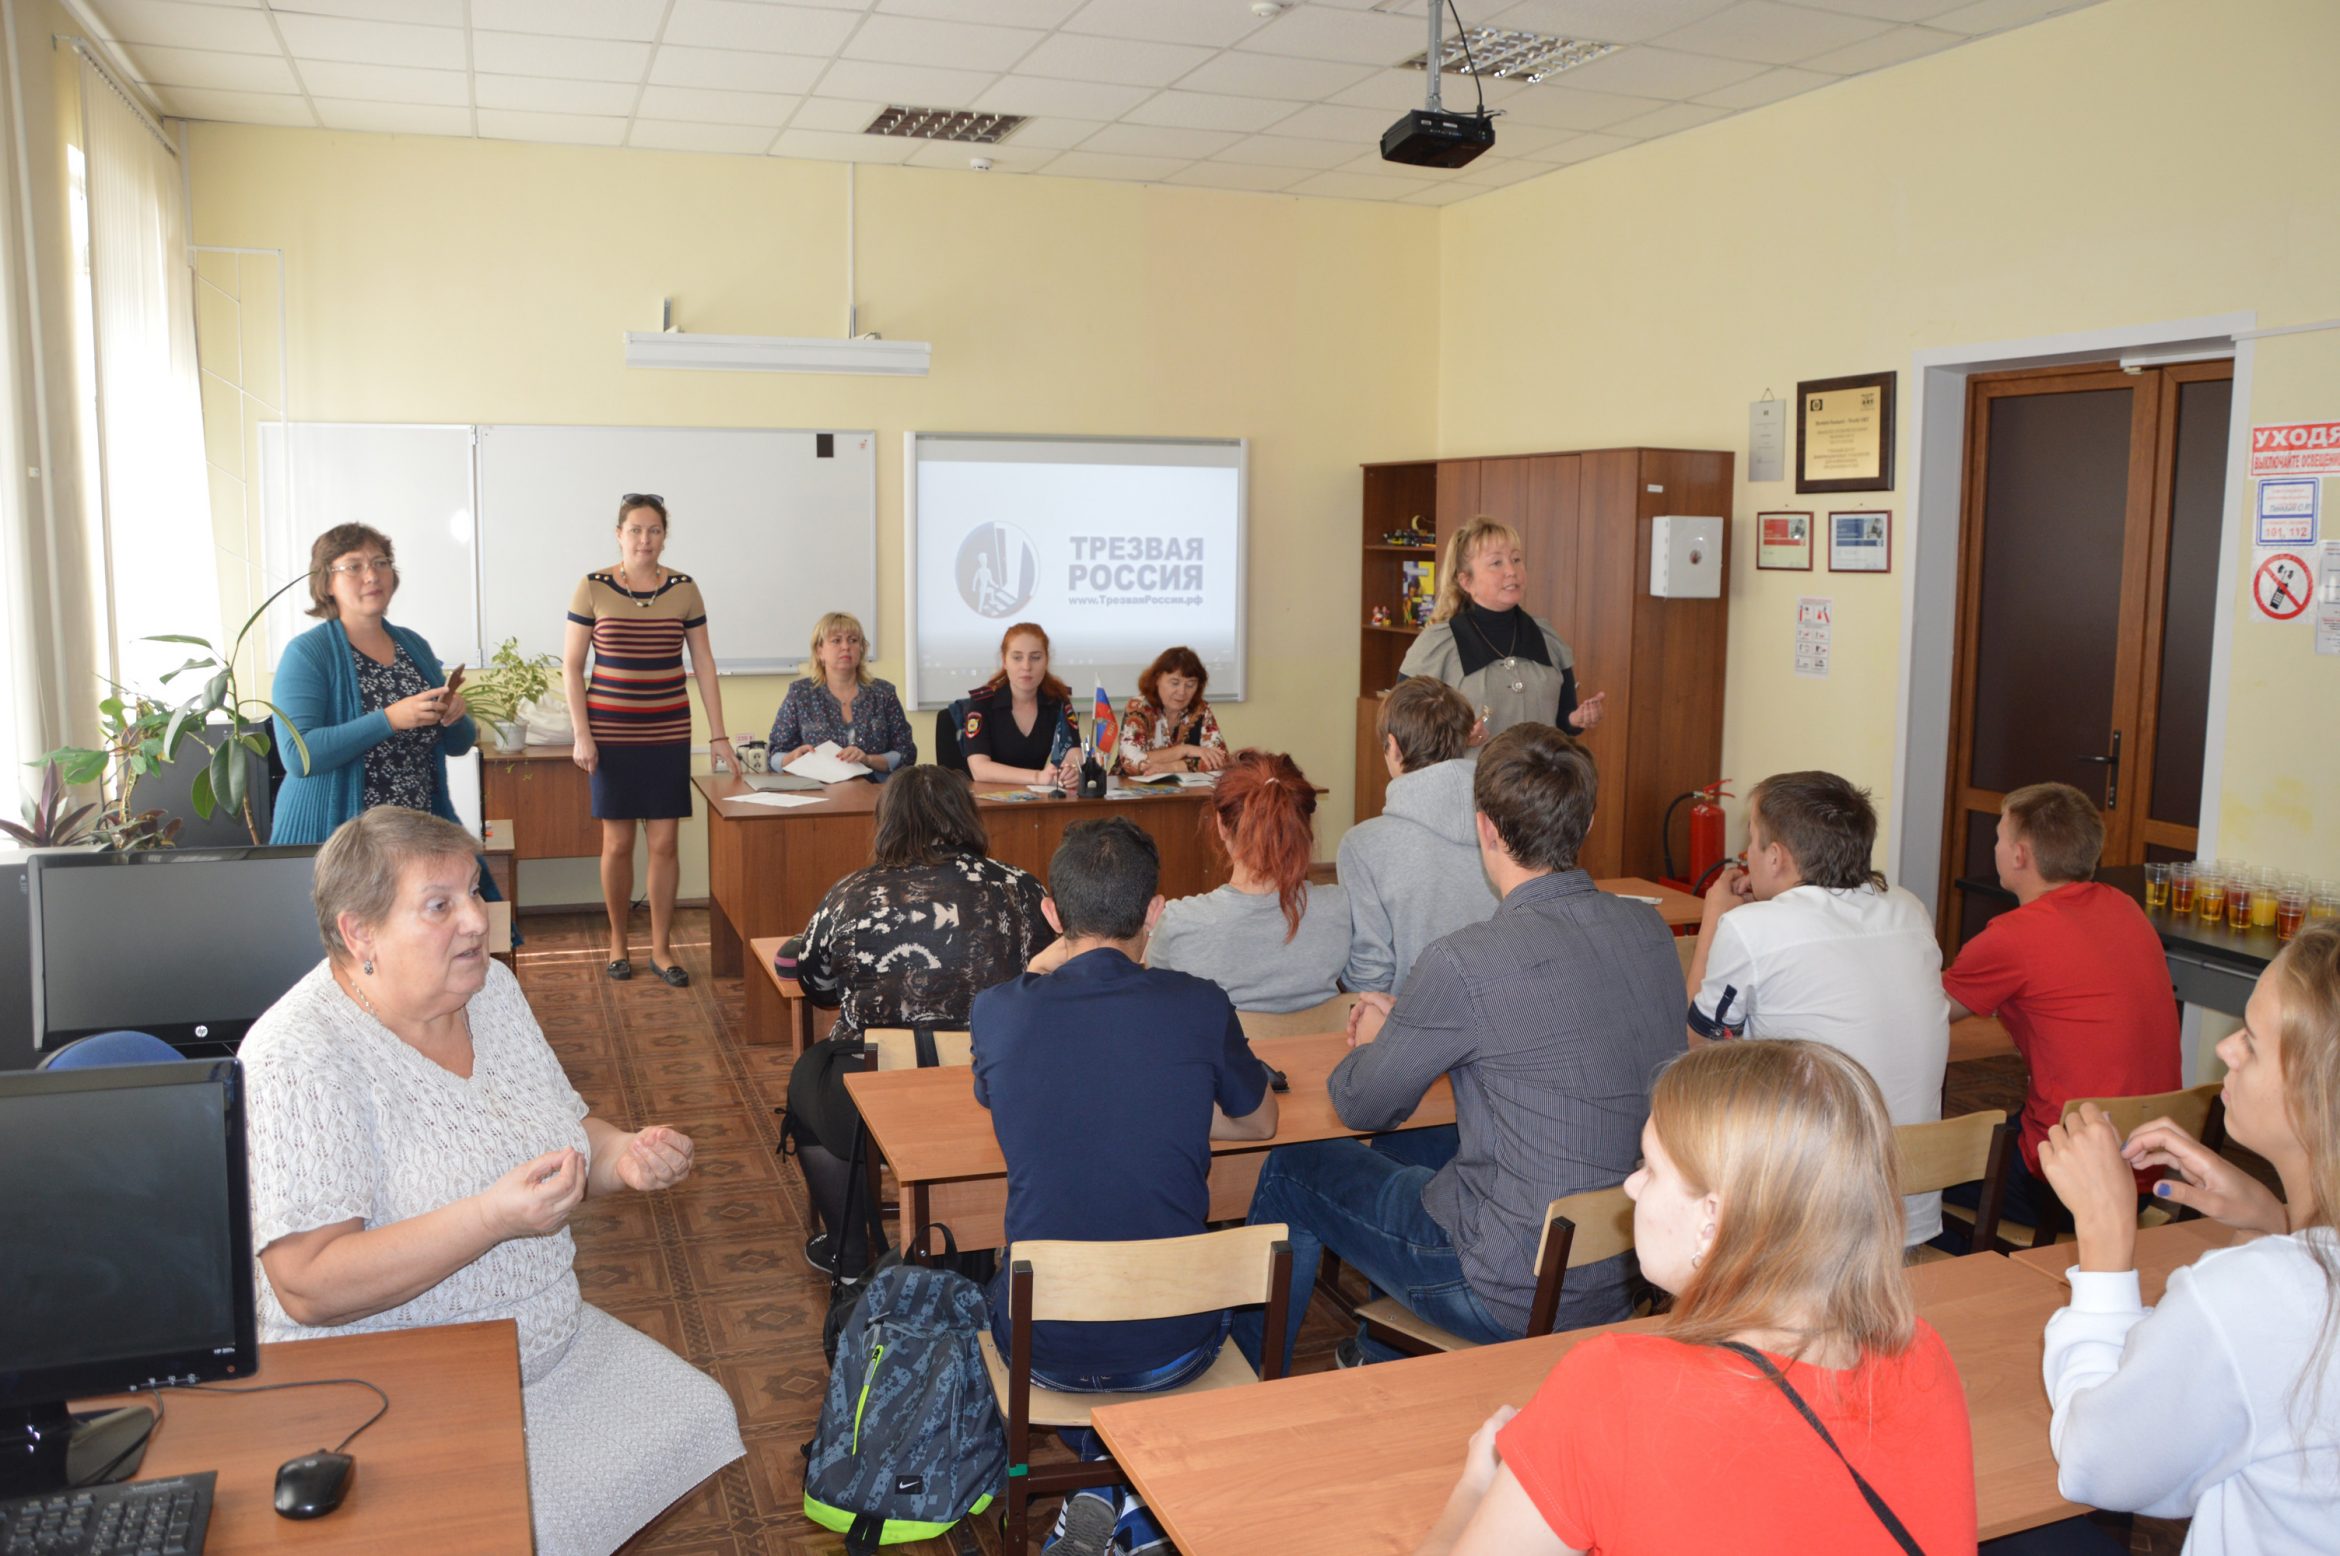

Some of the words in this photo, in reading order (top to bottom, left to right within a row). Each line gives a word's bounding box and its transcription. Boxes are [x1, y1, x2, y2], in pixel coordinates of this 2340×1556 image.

[2255, 427, 2340, 448] УХОДЯ
[1069, 536, 1204, 561] ТРЕЗВАЯ
[1068, 564, 1204, 591] РОССИЯ
[1068, 595, 1204, 607] www.ТрезваяРоссия.рф
